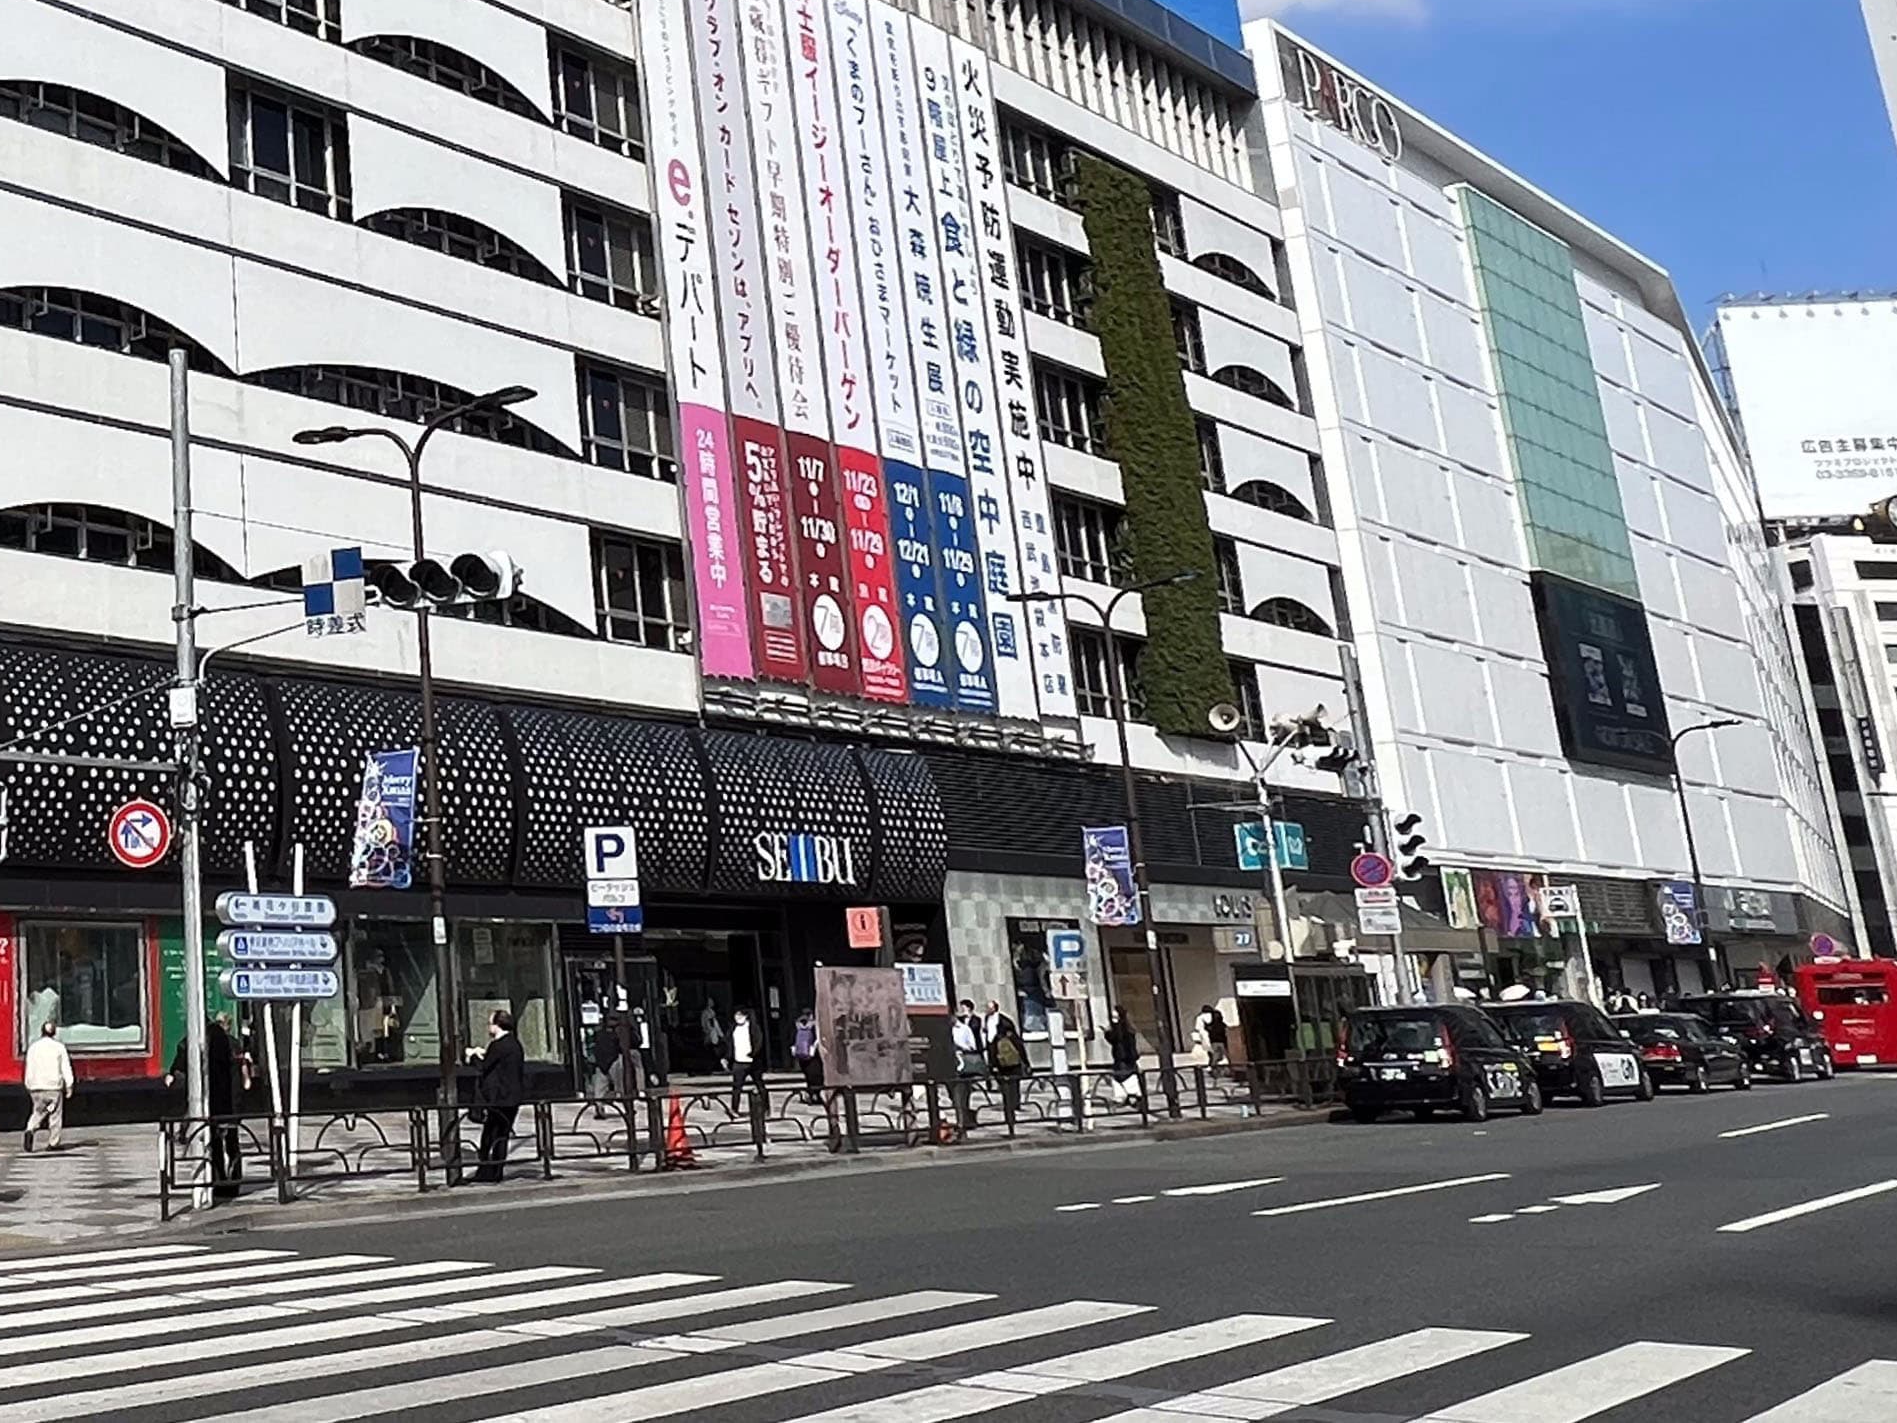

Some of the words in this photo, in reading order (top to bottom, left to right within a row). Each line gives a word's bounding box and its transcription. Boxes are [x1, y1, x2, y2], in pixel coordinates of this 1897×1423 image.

[1297, 49, 1403, 162] PARCO
[959, 54, 1037, 492] 火災予防運動実施中
[797, 455, 825, 483] 11/7
[843, 468, 878, 498] 11/23
[893, 481, 921, 509] 12/1
[800, 516, 837, 545] 11/30
[896, 539, 931, 568] 12/21
[305, 612, 367, 637] 時差式
[594, 833, 625, 874] P
[752, 830, 857, 886] SEIBU
[1212, 894, 1253, 918] LOUIS
[1053, 934, 1084, 970] P
